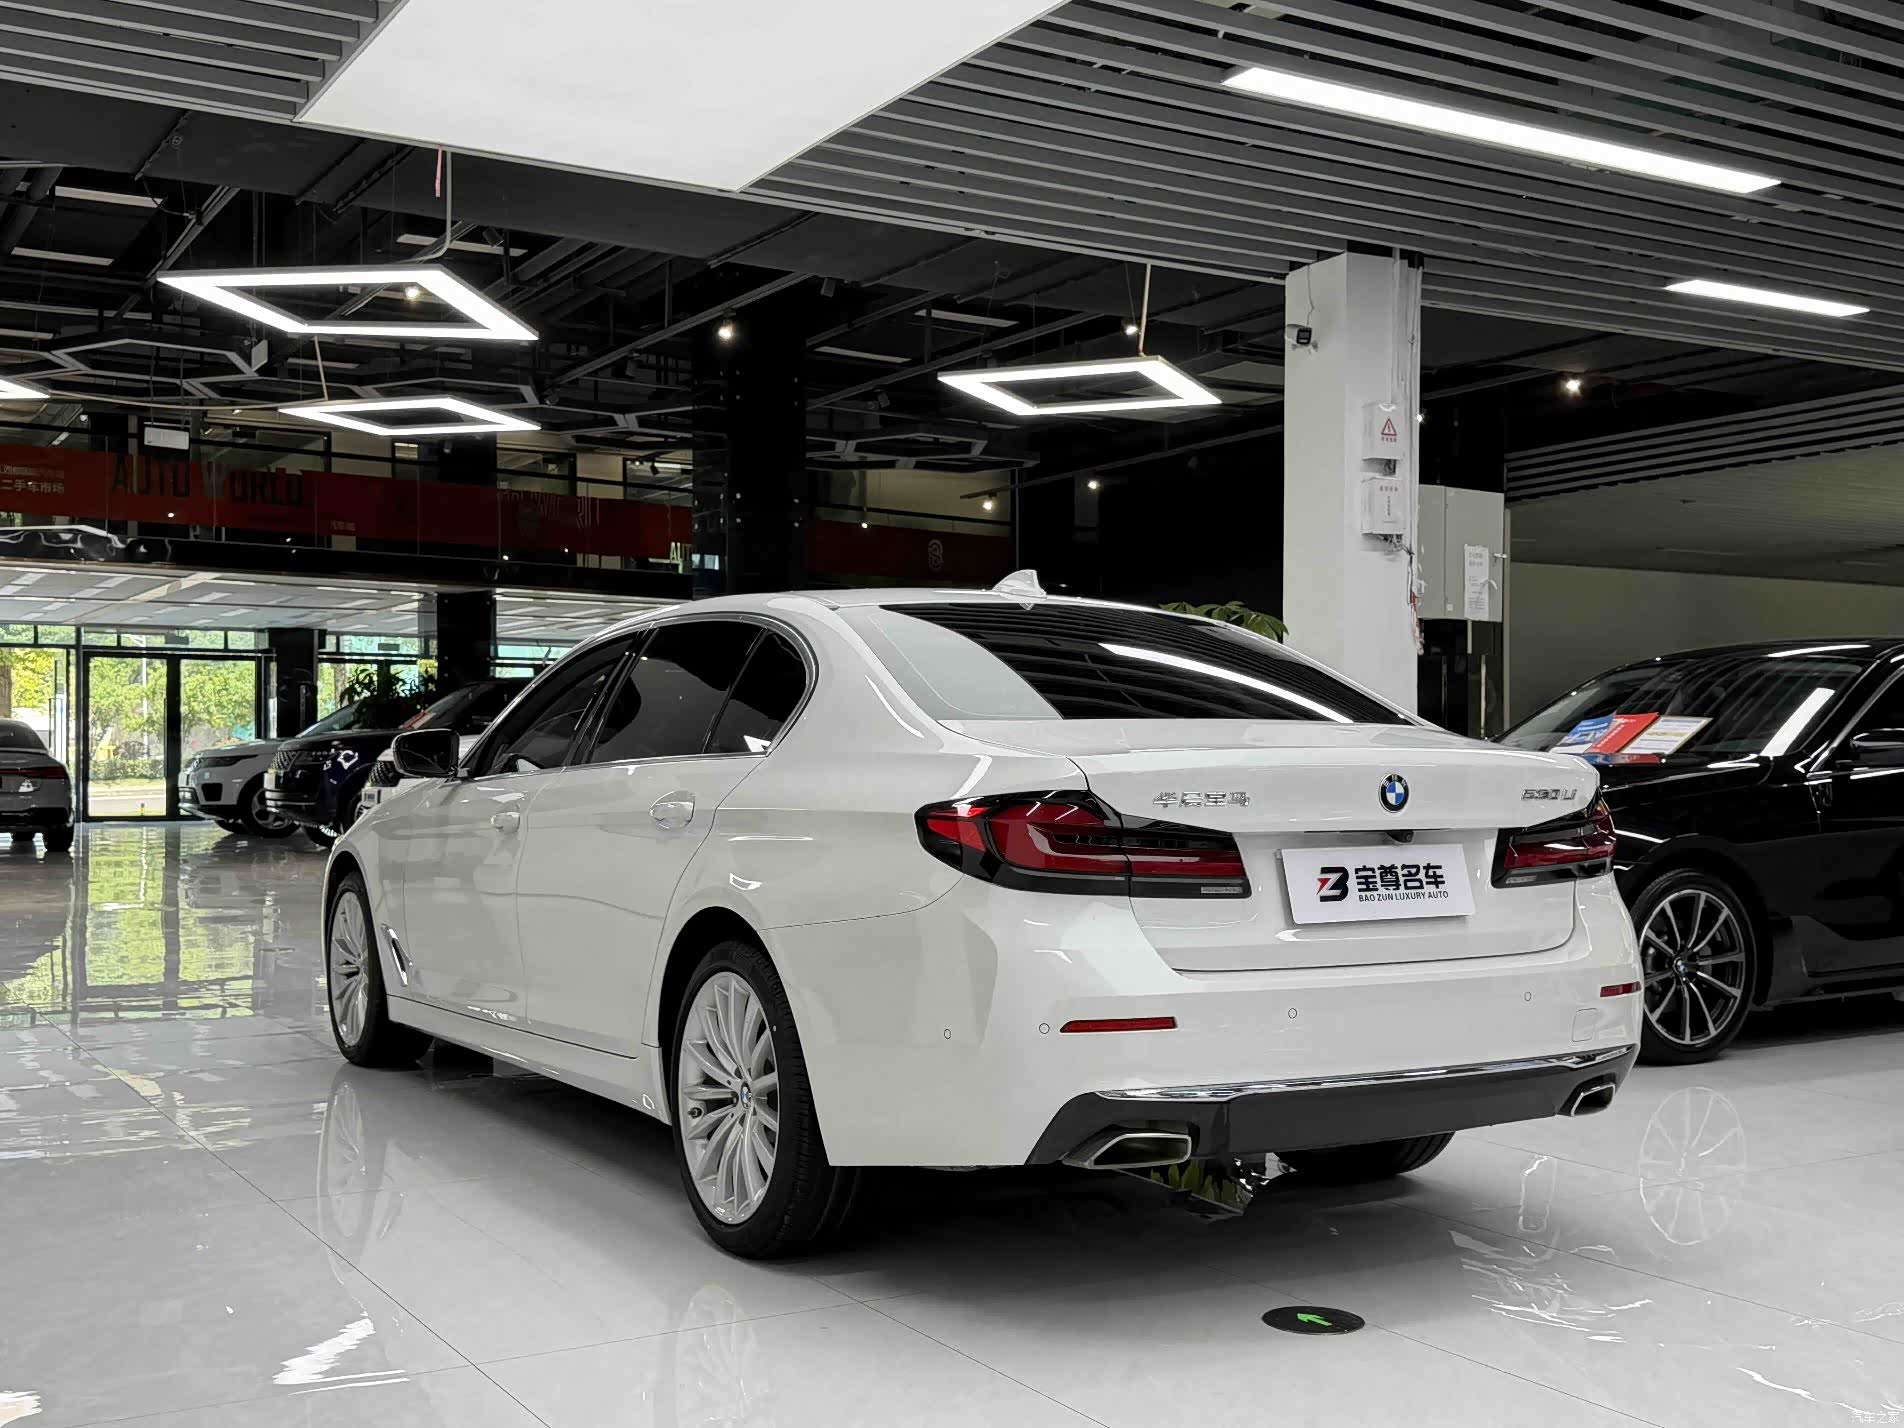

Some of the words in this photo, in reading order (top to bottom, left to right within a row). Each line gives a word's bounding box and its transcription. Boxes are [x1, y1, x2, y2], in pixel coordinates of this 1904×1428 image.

[111, 453, 191, 497] AUTO
[0, 480, 65, 494] 二手车市场
[1354, 863, 1445, 892] 宝尊名车
[1359, 895, 1375, 903] BAO
[1377, 893, 1394, 902] ZUN
[1395, 891, 1426, 901] LUXURY
[1428, 891, 1449, 899] AUTO
